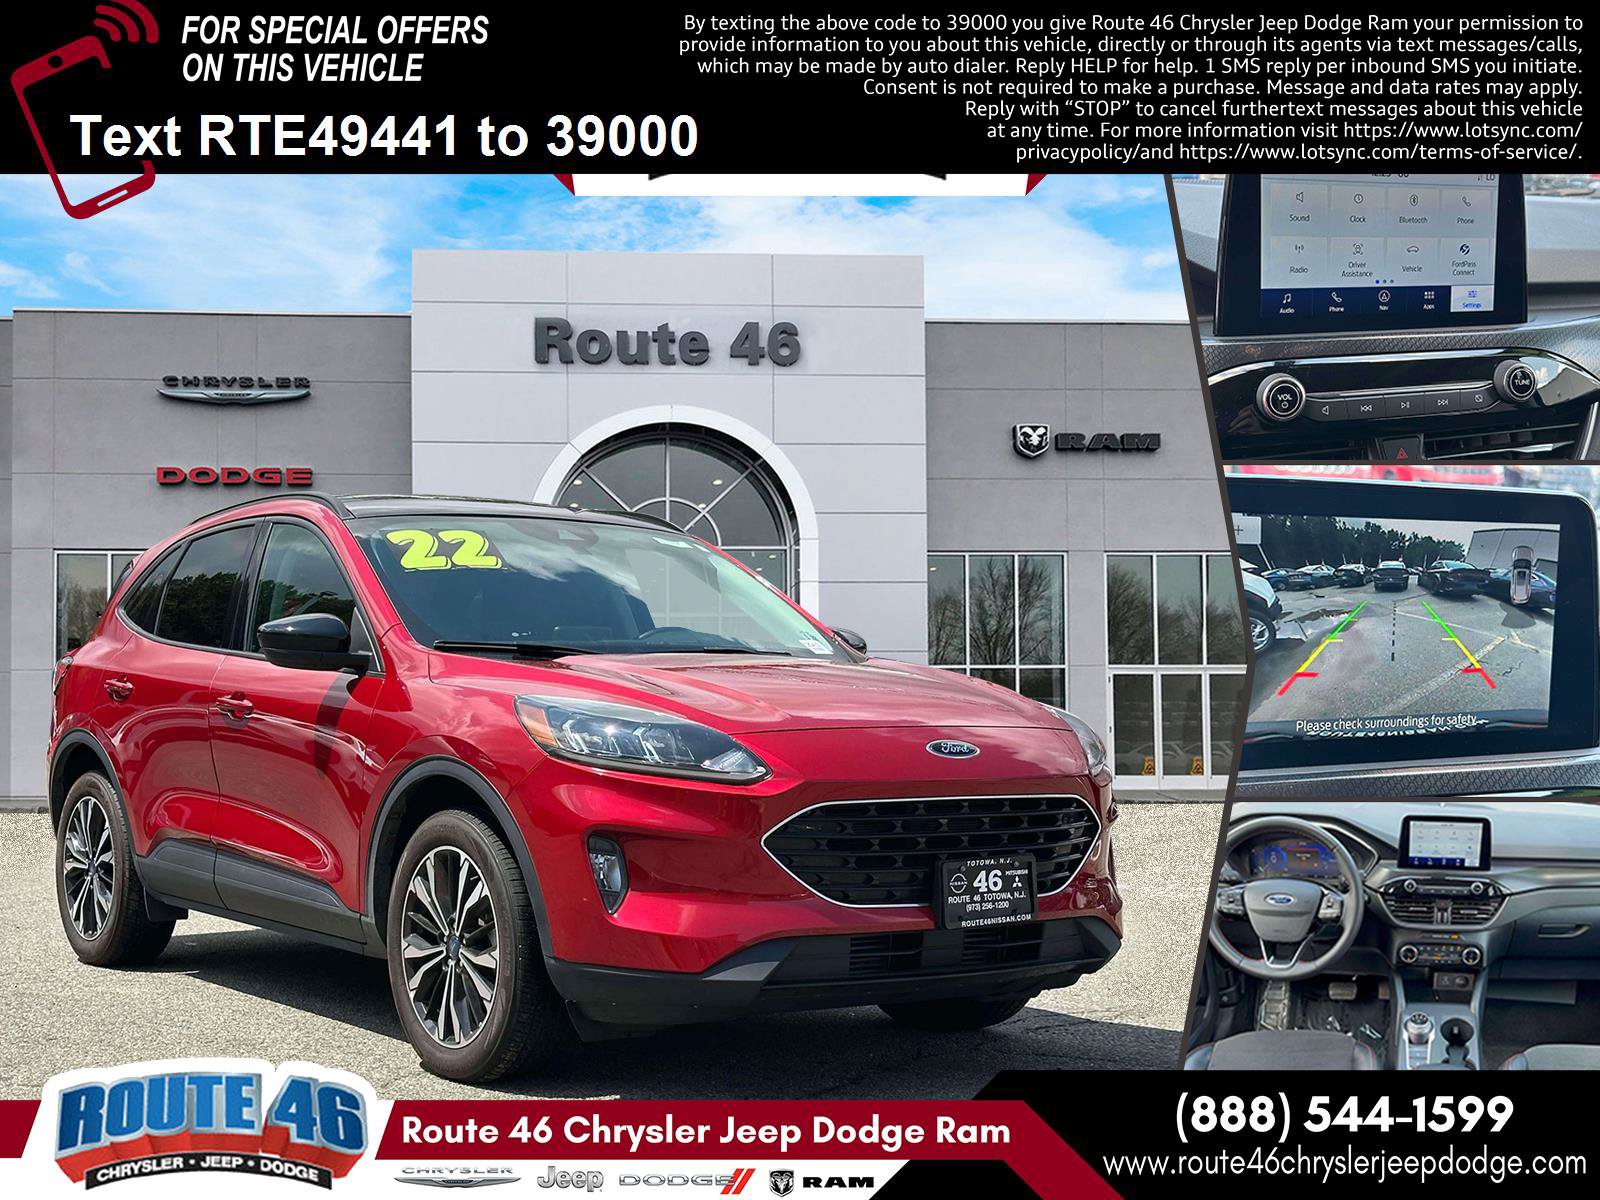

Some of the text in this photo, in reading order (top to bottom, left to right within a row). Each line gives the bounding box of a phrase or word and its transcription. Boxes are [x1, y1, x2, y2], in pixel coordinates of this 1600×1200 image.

[1289, 214, 1310, 223] Sound
[1349, 215, 1366, 223] Clock
[1399, 216, 1428, 224] Bluetooth
[1456, 216, 1475, 225] Phone
[1289, 266, 1308, 274] Radio
[1402, 265, 1422, 273] Vehicle
[534, 317, 801, 367] Route 46
[162, 375, 311, 388] CHRYSLER
[1277, 393, 1293, 401] VOL
[1054, 432, 1161, 451] RAM
[156, 466, 313, 486] DODGE
[386, 528, 502, 571] 22
[1295, 720, 1331, 733] Please
[1333, 717, 1363, 730] check
[1364, 715, 1430, 729] surroundings
[1430, 714, 1446, 726] for
[973, 869, 1003, 892] 46
[948, 895, 971, 904] ROUTE
[973, 894, 981, 902] 46
[966, 903, 981, 912] (973)
[961, 913, 1032, 928] ROUTE46NISSAN.COM
